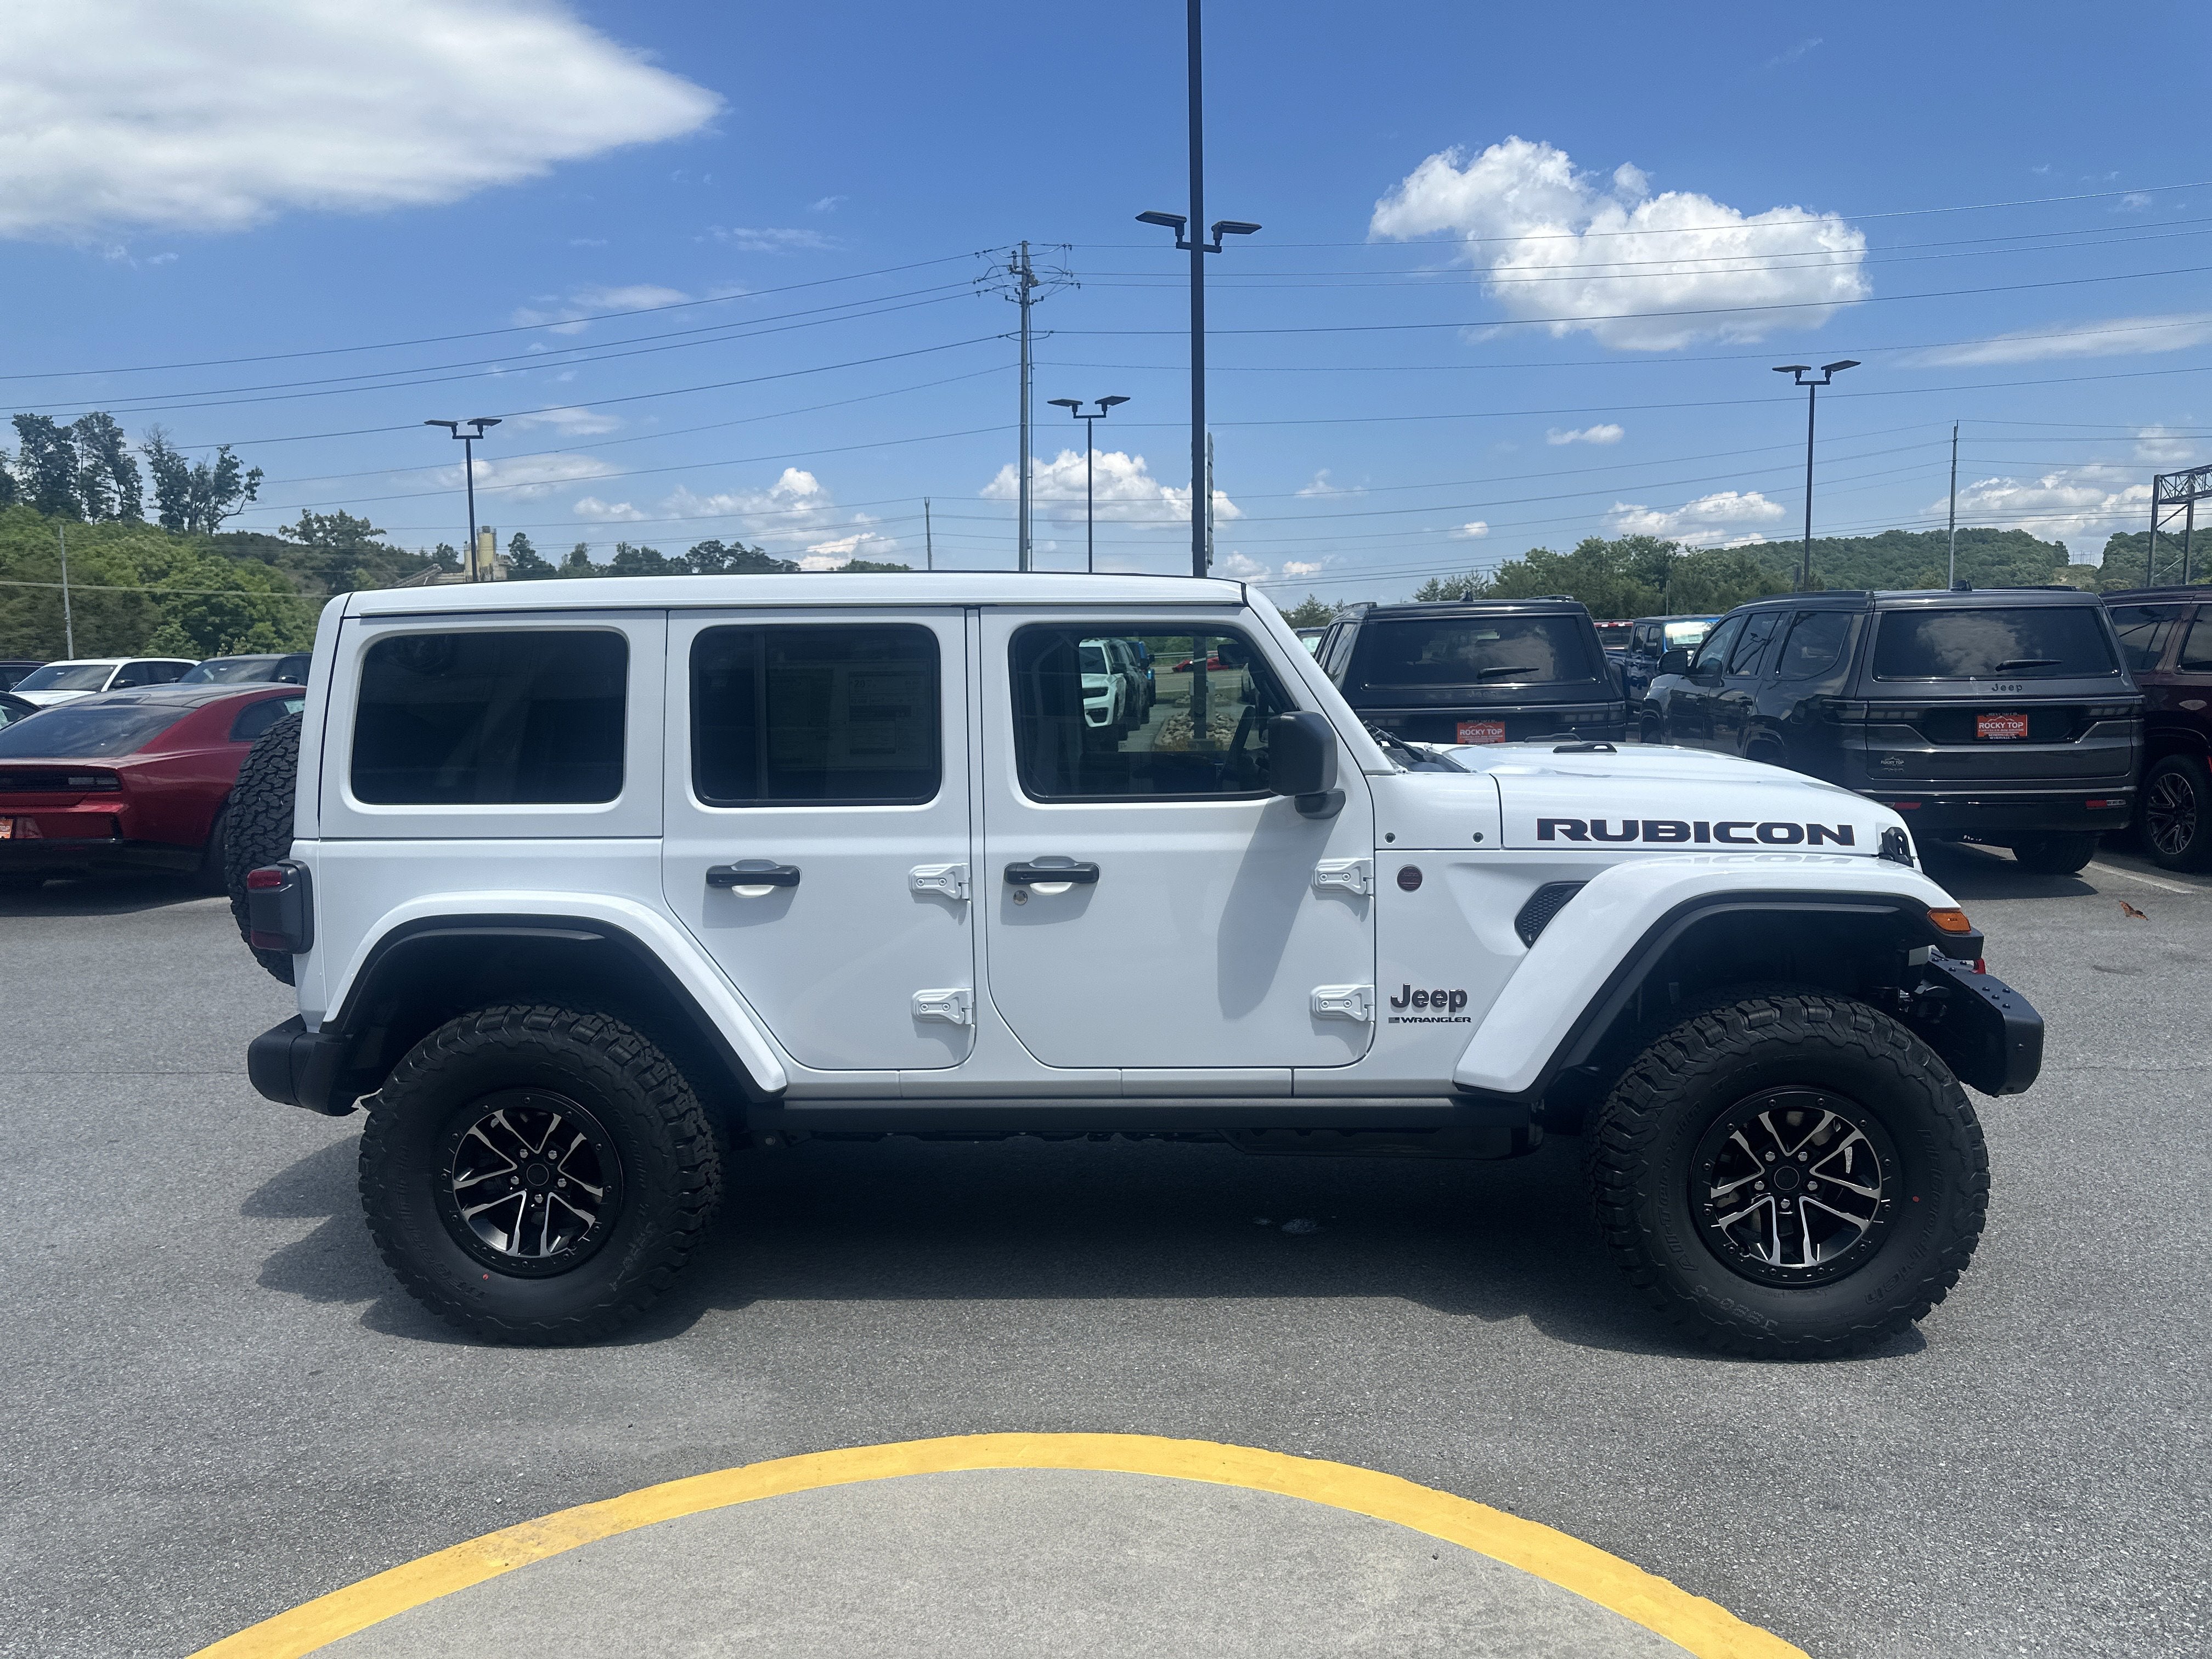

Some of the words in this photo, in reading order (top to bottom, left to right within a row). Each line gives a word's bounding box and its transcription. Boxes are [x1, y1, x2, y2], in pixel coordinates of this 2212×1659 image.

[1991, 683, 2023, 692] Jeep
[1537, 818, 1855, 846] RUBICON
[1391, 983, 1468, 1012] Jeep
